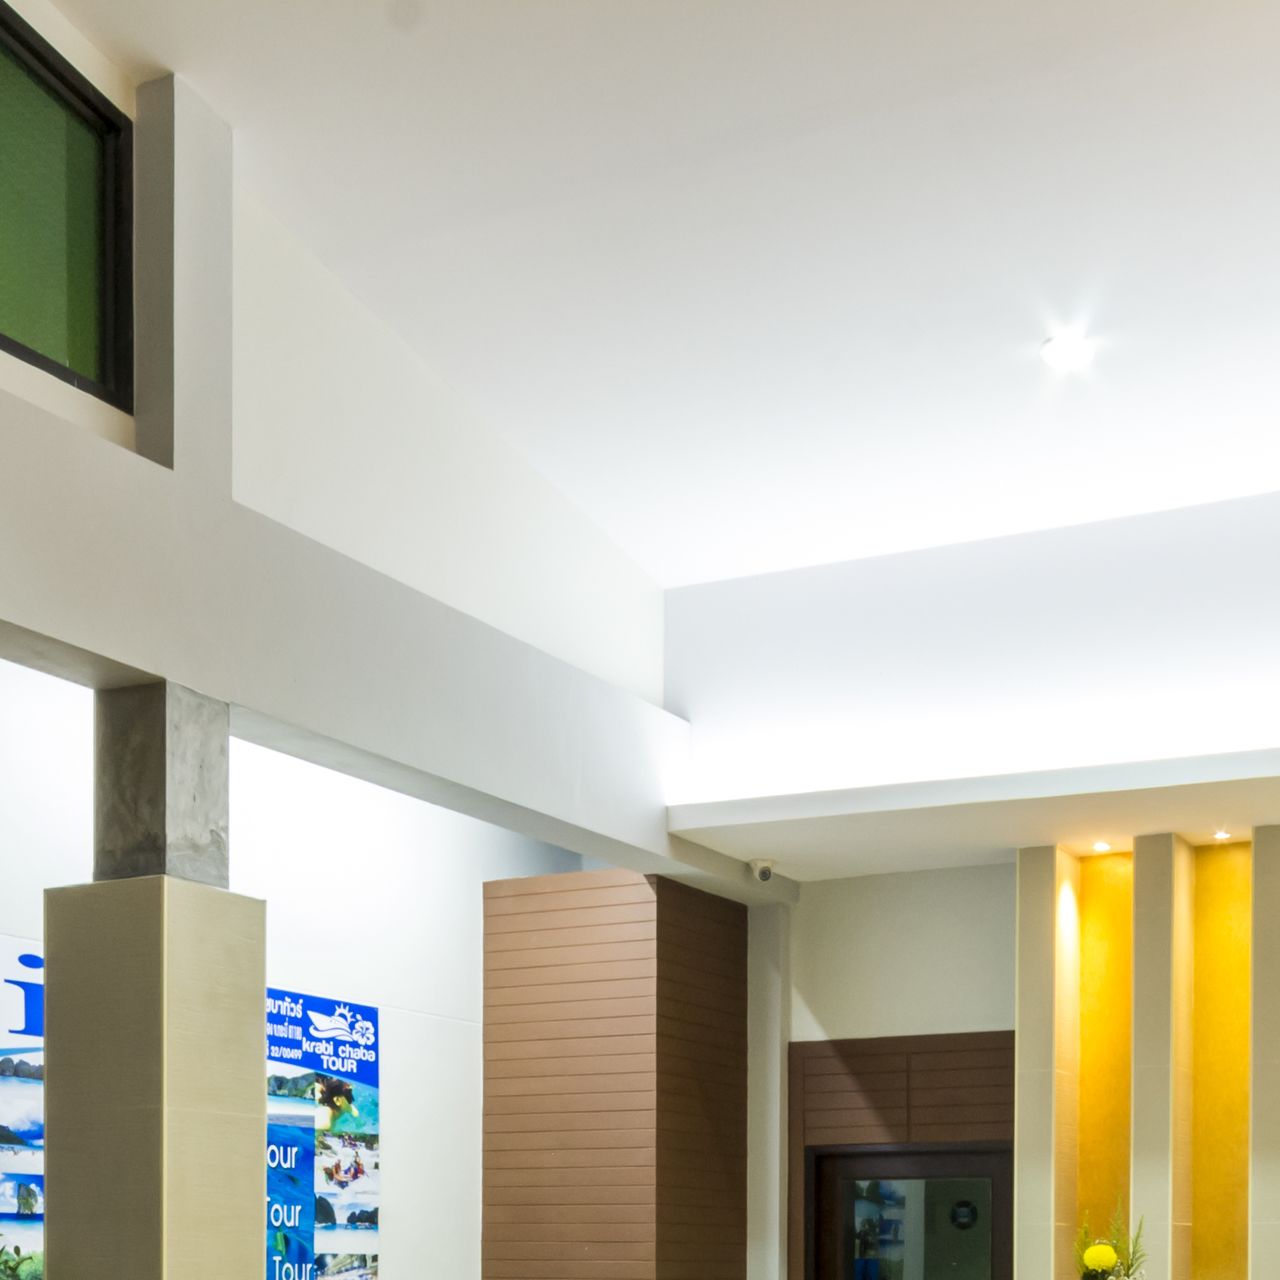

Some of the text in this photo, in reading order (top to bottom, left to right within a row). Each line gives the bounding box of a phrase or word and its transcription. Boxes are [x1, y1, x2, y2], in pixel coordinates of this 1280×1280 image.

[302, 1036, 376, 1062] krabi chaba
[320, 1054, 357, 1073] TOUR
[266, 1143, 299, 1169] our
[266, 1196, 302, 1228] our
